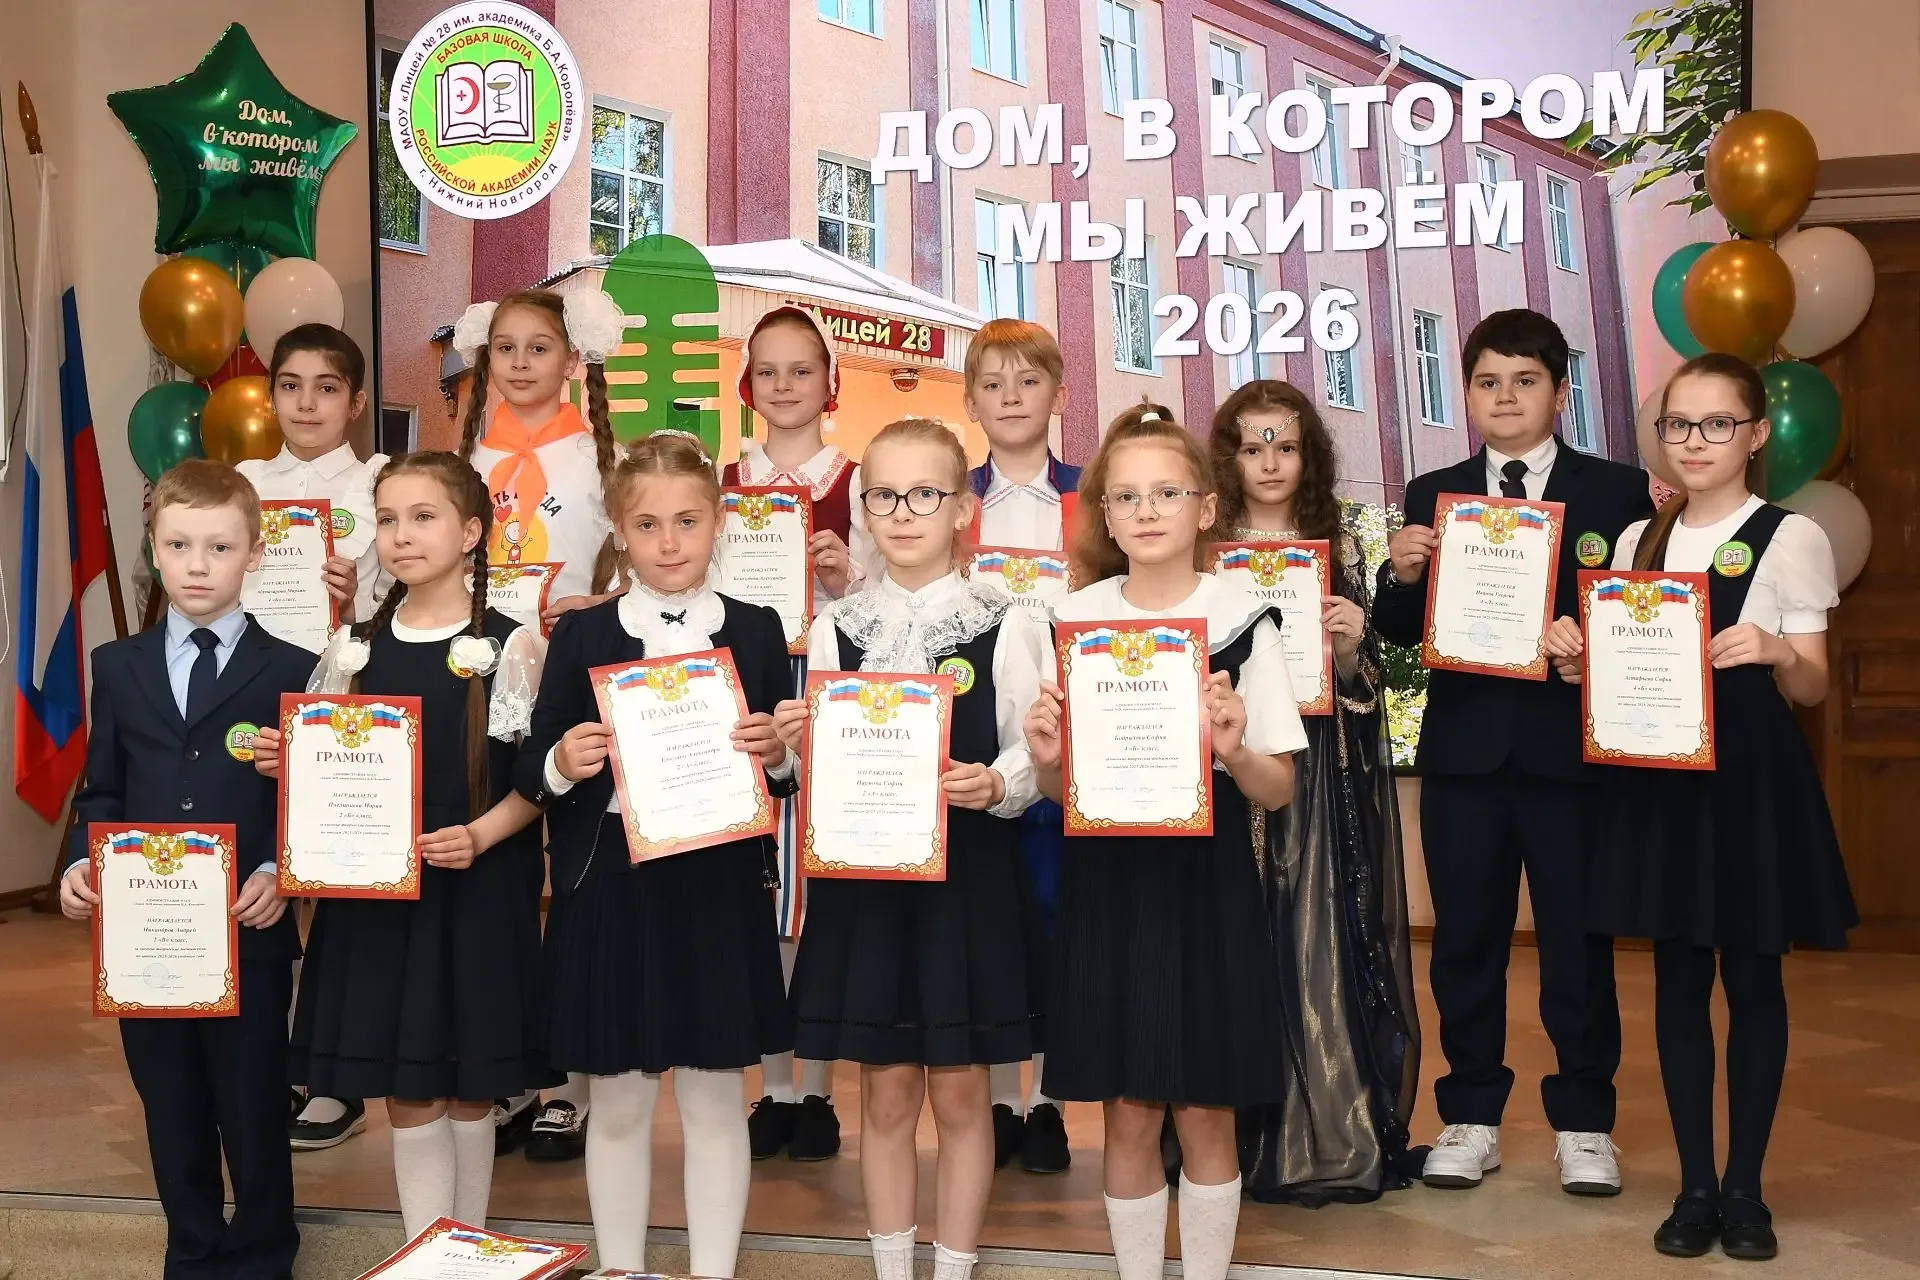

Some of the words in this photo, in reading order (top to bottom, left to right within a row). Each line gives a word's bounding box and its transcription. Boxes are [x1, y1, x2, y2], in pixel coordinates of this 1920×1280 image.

[436, 23, 451, 38] 28
[454, 14, 475, 27] им.
[478, 13, 543, 42] академика
[436, 32, 490, 64] БАЗОВАЯ
[492, 32, 534, 62] ШКОЛА
[400, 51, 425, 102] «Лицей
[238, 100, 292, 128] Дом,
[398, 108, 413, 150] МАОУ
[870, 102, 1091, 185] ДОМ,
[1210, 67, 1667, 158] КОТОРОМ
[222, 130, 319, 156] котором
[198, 154, 240, 172] мы
[250, 157, 322, 180] живём
[416, 128, 476, 192] РОССИЙСКОЙ
[480, 156, 541, 193] АКАДЕМИИ
[540, 120, 558, 156] НАУК
[428, 177, 484, 210] Нижний
[489, 164, 558, 209] Новгород
[996, 197, 1146, 265] МЫ
[1174, 167, 1526, 259] ЖИВЁМ
[1151, 287, 1362, 358] 2026
[901, 323, 932, 352] 28
[728, 533, 783, 544] ГРАМОТА
[263, 547, 304, 556] МОТА
[1464, 544, 1525, 560] ГРАМОТА
[487, 590, 518, 598] МОТА
[1011, 596, 1046, 608] МОТА
[1612, 625, 1673, 638] ГРАМОТА
[1097, 680, 1168, 693] ГРАМОТА
[640, 700, 709, 720] ГРАМОТА
[841, 728, 911, 740] ГРАМОТА
[316, 751, 384, 764] ГРАМОТА
[128, 878, 198, 890] ГРАМОТА
